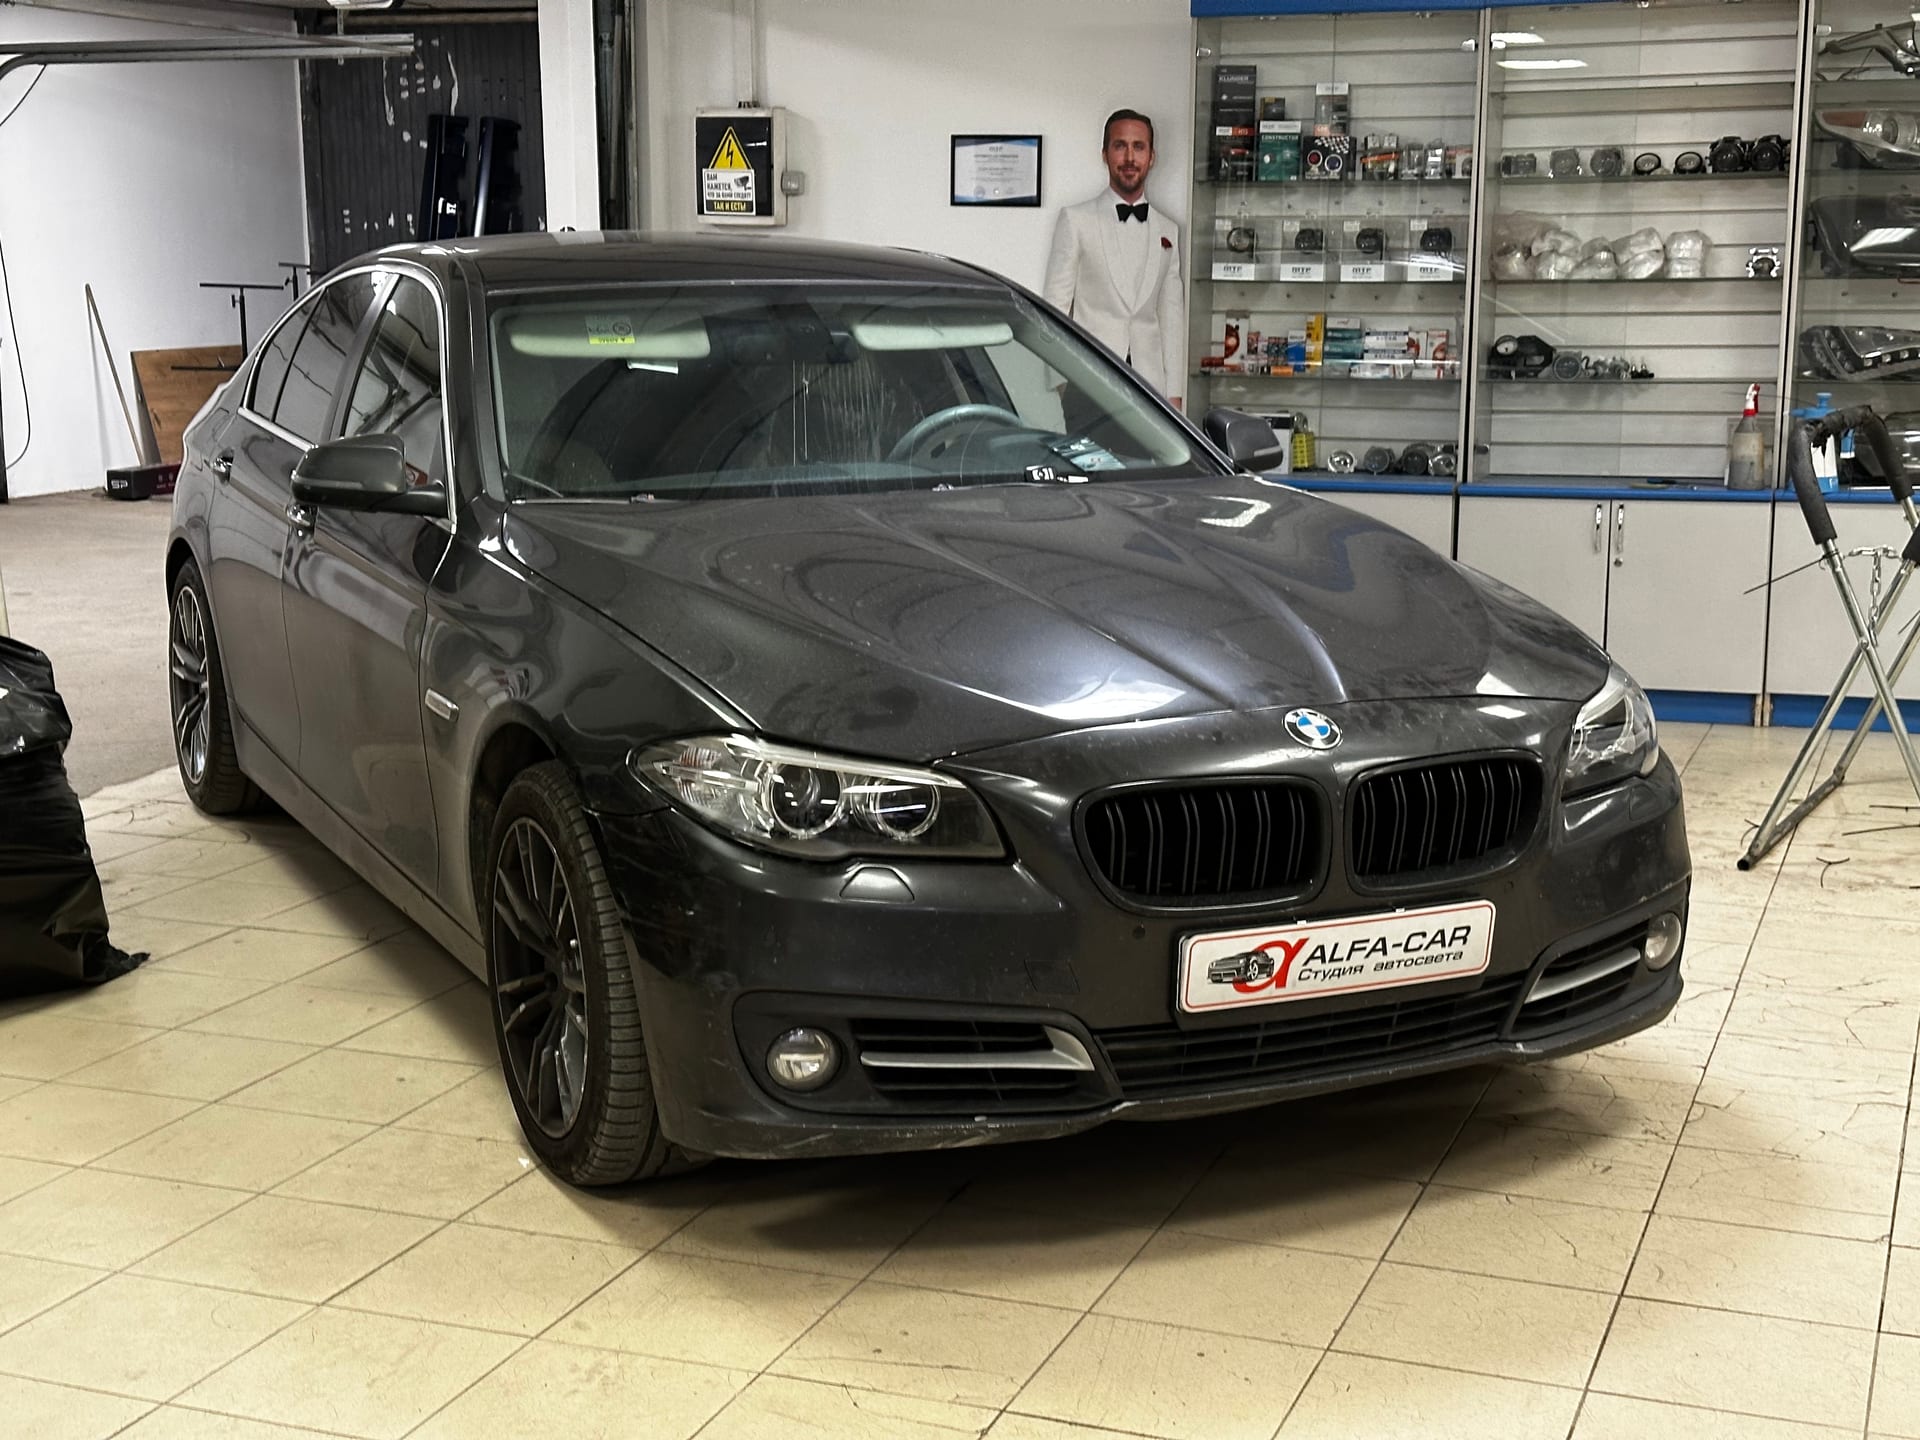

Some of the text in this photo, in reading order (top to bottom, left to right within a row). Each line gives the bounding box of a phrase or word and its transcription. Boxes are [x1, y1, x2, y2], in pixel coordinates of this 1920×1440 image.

[707, 173, 717, 181] ВАМ
[707, 183, 732, 191] КАЖЕТСЯ,
[713, 202, 725, 210] ТАК
[730, 202, 746, 211] ЕСТЬ!
[111, 479, 128, 489] SP
[1302, 925, 1472, 967] ALFA-CAR
[1298, 950, 1464, 982] Студия автосвета
